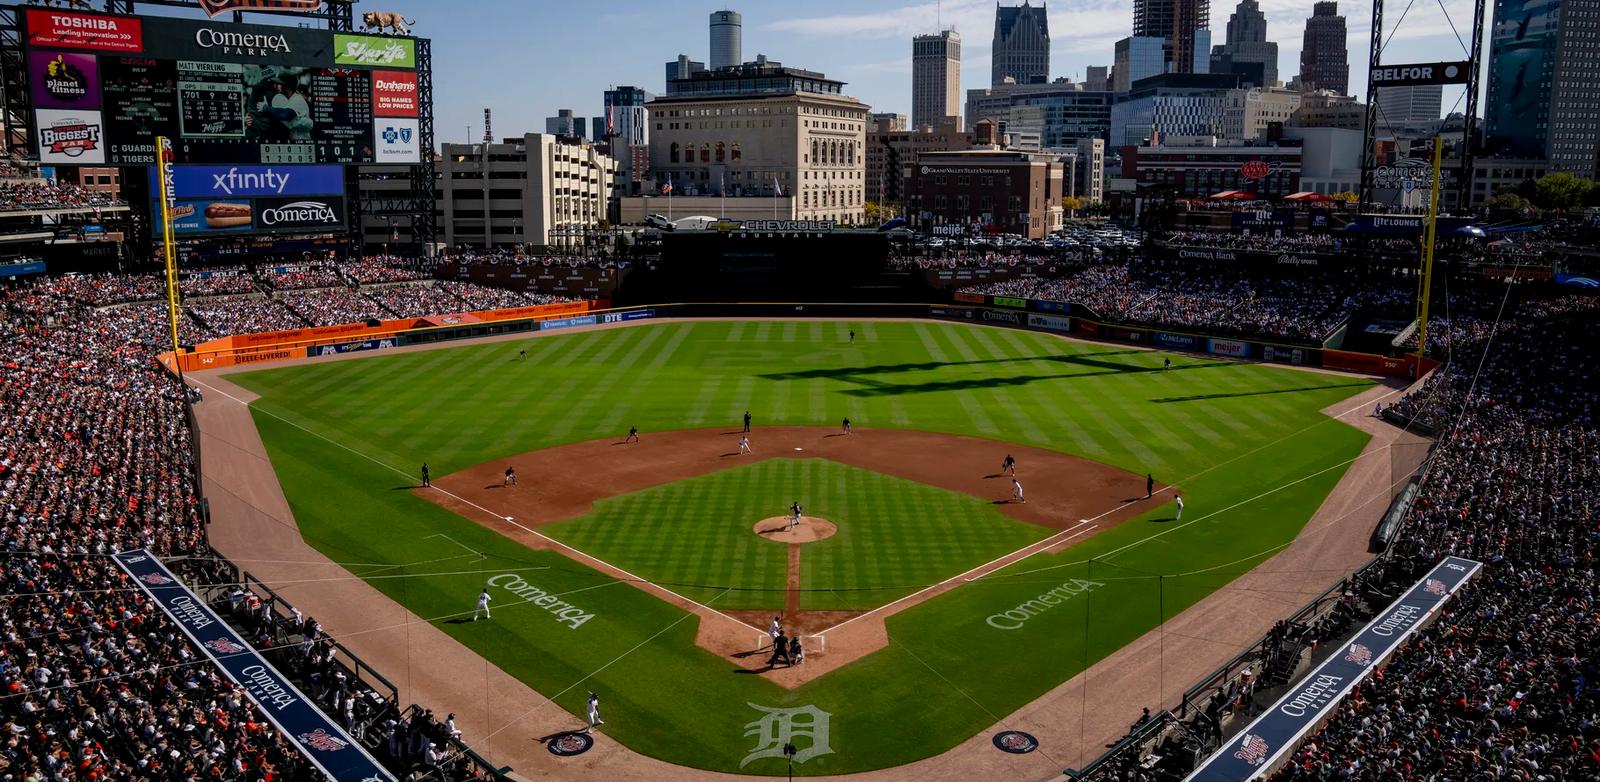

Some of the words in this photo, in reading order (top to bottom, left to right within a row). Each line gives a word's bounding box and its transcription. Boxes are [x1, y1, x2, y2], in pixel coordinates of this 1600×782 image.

[51, 15, 118, 31] TOSHIBA
[53, 28, 81, 37] Leading
[82, 30, 118, 39] Innovation
[196, 28, 291, 53] Comerica
[224, 46, 267, 56] PARK
[179, 62, 194, 70] MATT
[196, 63, 226, 72] VIERLING
[1373, 67, 1433, 81] BELFOR
[47, 80, 79, 88] planet
[52, 86, 86, 94] fitness
[375, 80, 415, 90] Dunham's
[42, 125, 98, 146] BIGGEST
[320, 147, 325, 155] 1
[334, 147, 340, 155] 0
[349, 147, 354, 155] 1
[161, 138, 176, 208] ROCKET
[212, 168, 290, 194] xfinity
[262, 207, 338, 225] Comerica
[744, 219, 836, 231] CHEVROLET
[1390, 219, 1420, 227] LOUNGE
[83, 248, 111, 256] MARKET
[1179, 250, 1214, 260] Comerica
[1216, 252, 1236, 260] Bank
[1278, 254, 1300, 266] Bally
[605, 313, 622, 323] DTE
[1214, 341, 1241, 352] meijer
[487, 573, 596, 630] Comerica
[986, 578, 1106, 630] Comerica
[170, 595, 215, 630] Comerica
[1371, 604, 1421, 637] Comerica
[241, 664, 298, 711] Comerica
[1281, 674, 1344, 717] Comerica
